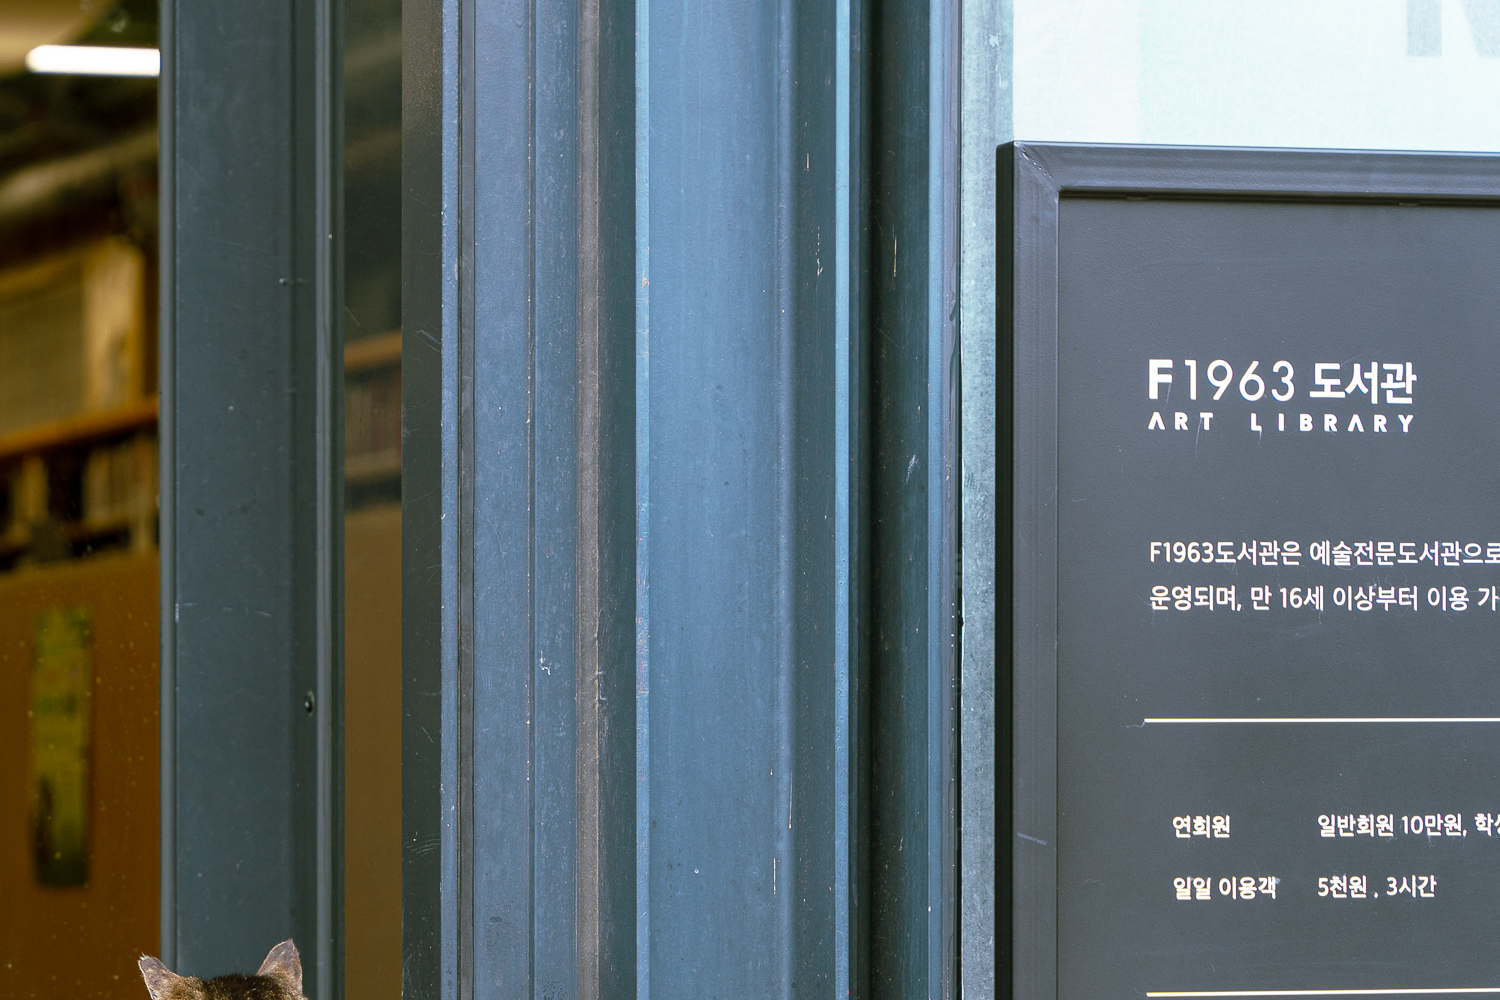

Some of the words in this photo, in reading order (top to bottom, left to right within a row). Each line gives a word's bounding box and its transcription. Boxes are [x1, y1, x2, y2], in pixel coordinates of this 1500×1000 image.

[1148, 358, 1295, 402] F1963
[1309, 361, 1418, 405] 도서관
[1147, 411, 1214, 432] ART
[1250, 412, 1414, 434] LIBRARY
[1150, 539, 1303, 567] F1963도서관은
[1309, 539, 1500, 567] 예술전문도서관으로
[1149, 584, 1242, 612] 운영되며,
[1250, 584, 1273, 611] 만
[1279, 585, 1325, 612] 16세
[1332, 584, 1419, 612] 이상부터
[1427, 585, 1470, 612] 이용
[1477, 585, 1500, 612] 가
[1172, 814, 1231, 839] 연회원
[1317, 813, 1394, 838] 일반회원
[1401, 813, 1468, 838] 10만원,
[1173, 876, 1212, 901] 일일
[1218, 876, 1278, 900] 이용객
[1317, 874, 1368, 899] 5천원
[1386, 874, 1438, 899] 3시간
